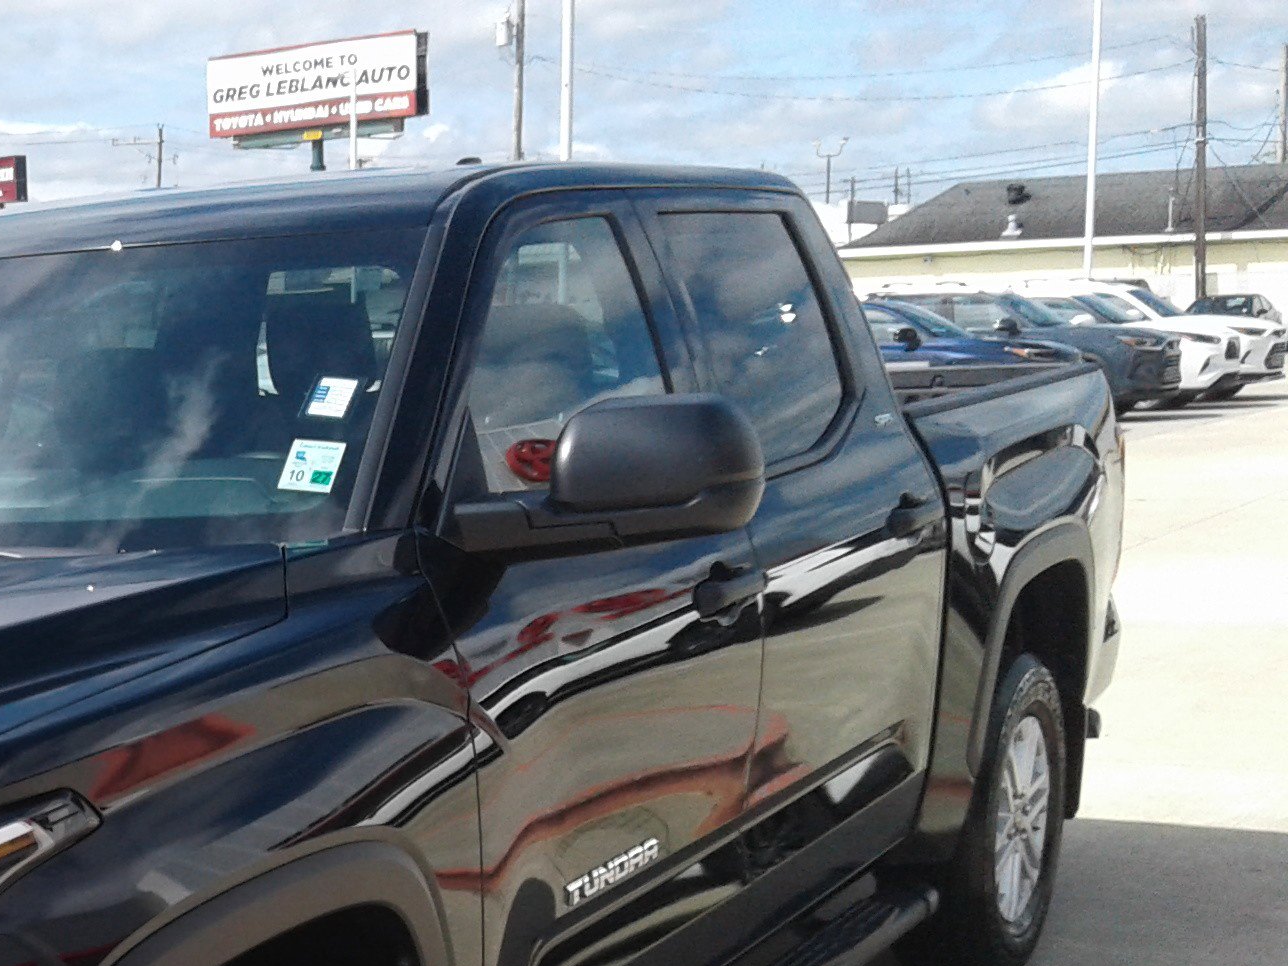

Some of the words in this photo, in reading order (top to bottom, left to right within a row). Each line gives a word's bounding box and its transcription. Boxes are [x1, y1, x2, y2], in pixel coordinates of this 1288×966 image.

[262, 56, 334, 77] WELCOME
[341, 54, 358, 67] TO
[213, 84, 261, 104] GREG
[265, 72, 351, 97] LEBLANC
[356, 65, 410, 86] AUTO
[214, 114, 264, 131] TOYOTA
[273, 104, 329, 124] HYUNDAI
[289, 469, 305, 482] 10
[565, 837, 659, 906] TUNDRA
